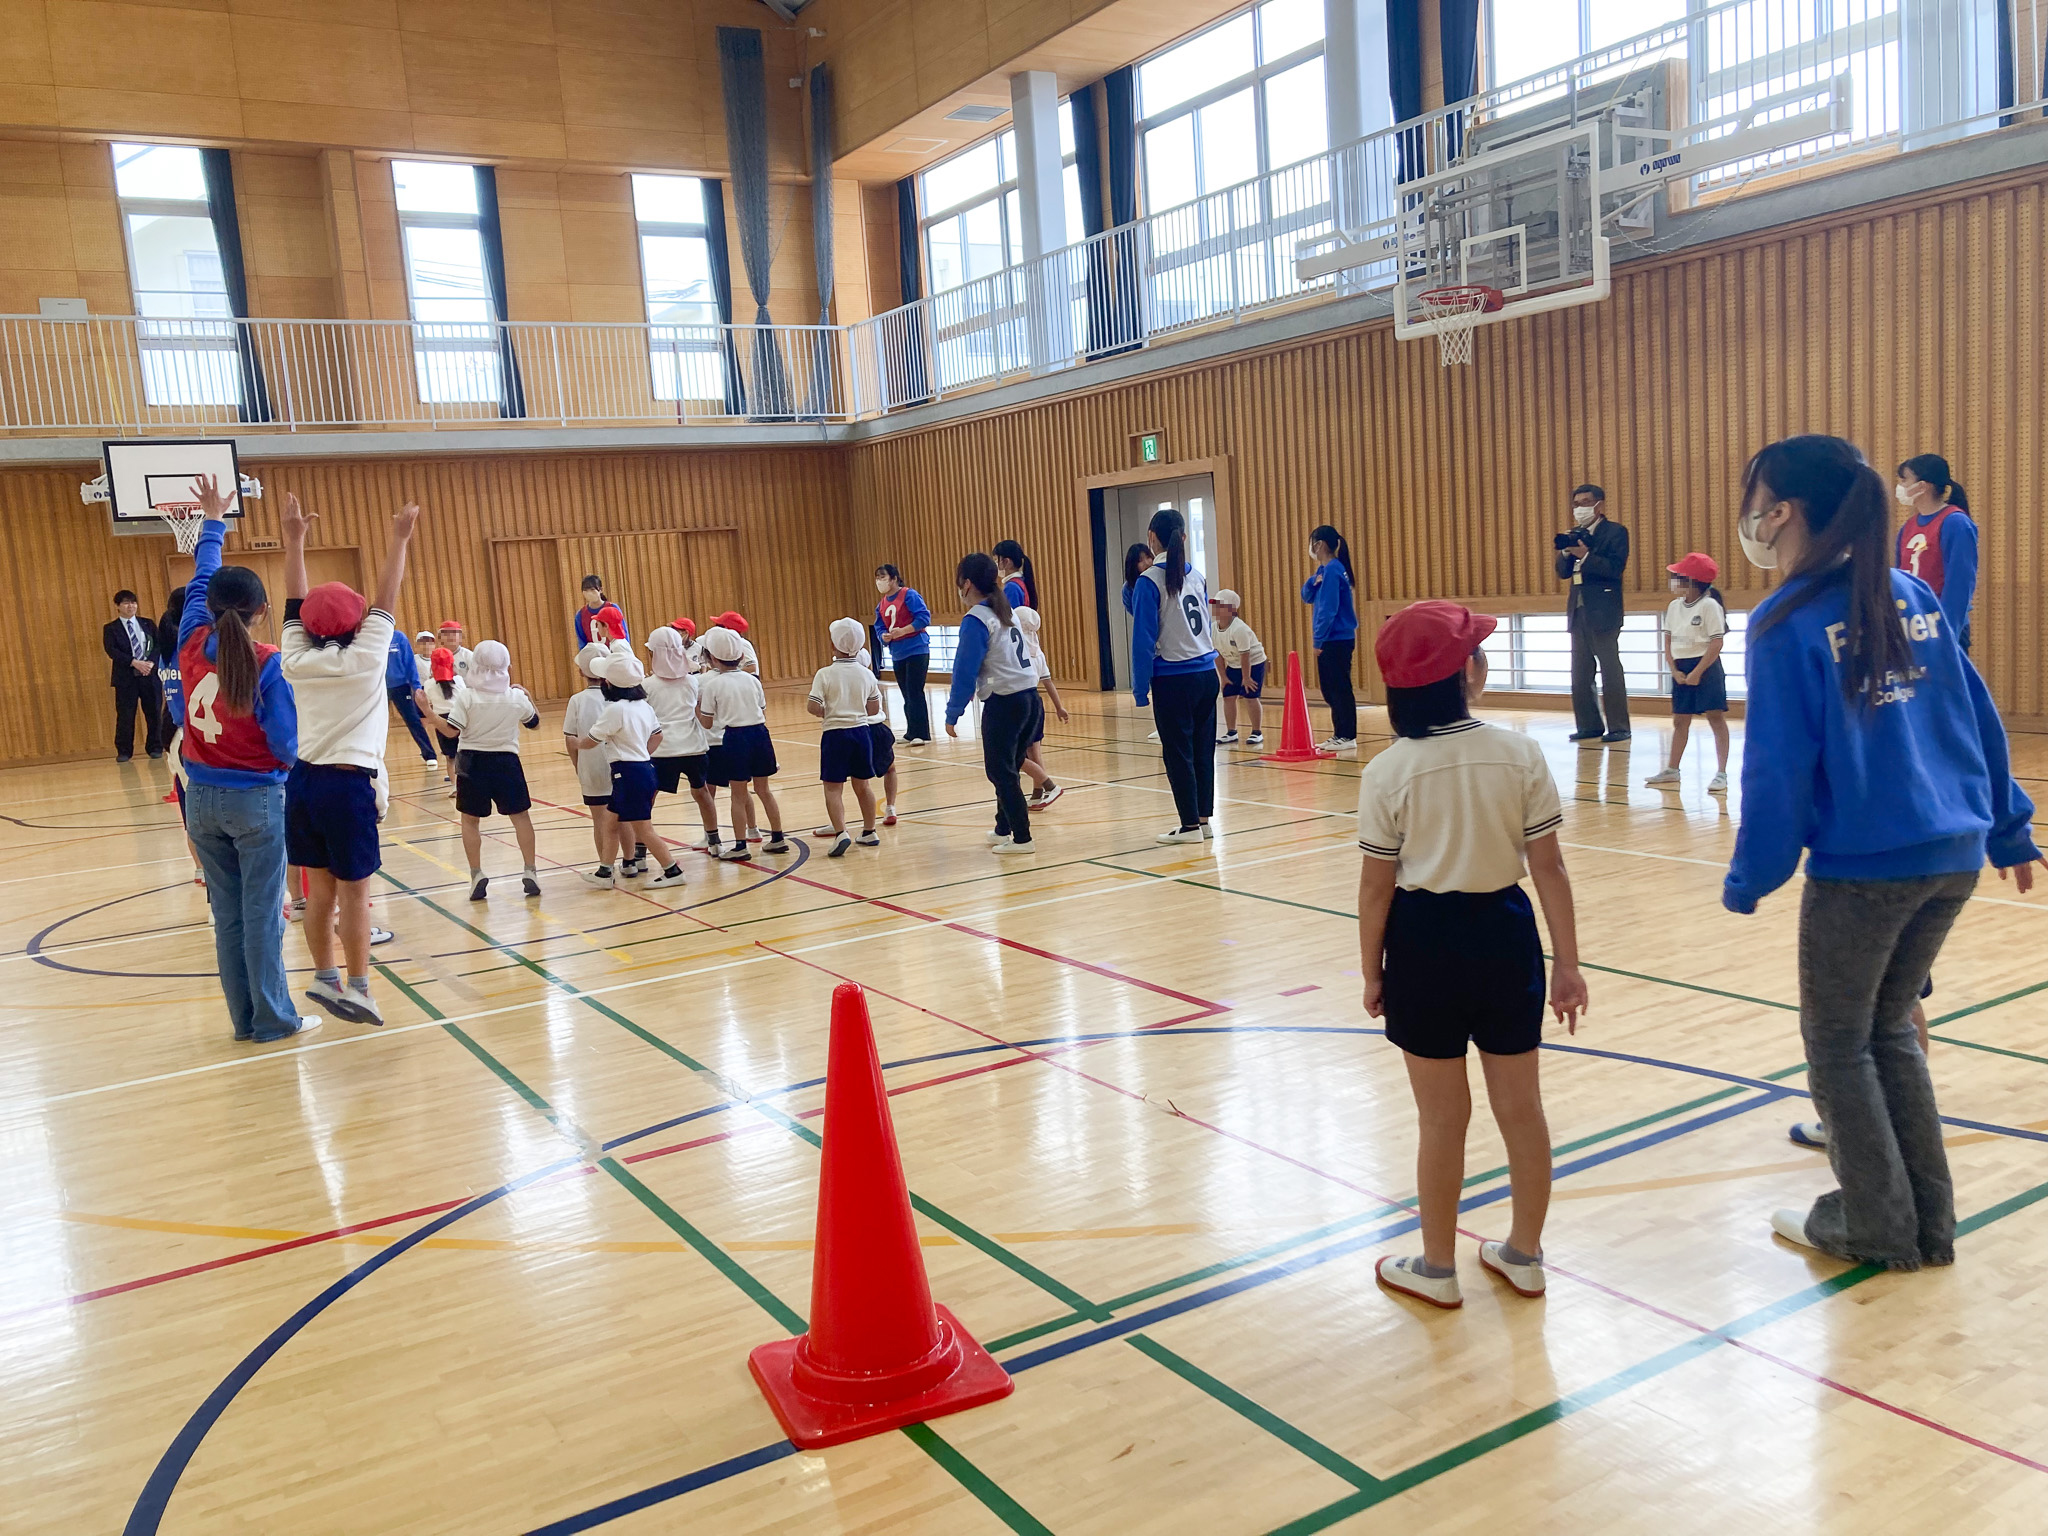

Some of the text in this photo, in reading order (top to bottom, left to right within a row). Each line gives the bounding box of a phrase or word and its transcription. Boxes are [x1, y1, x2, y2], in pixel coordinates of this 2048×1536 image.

[1182, 594, 1203, 637] 6
[1825, 598, 1941, 663] Fier
[1010, 627, 1031, 669] 2
[188, 671, 223, 745] 4
